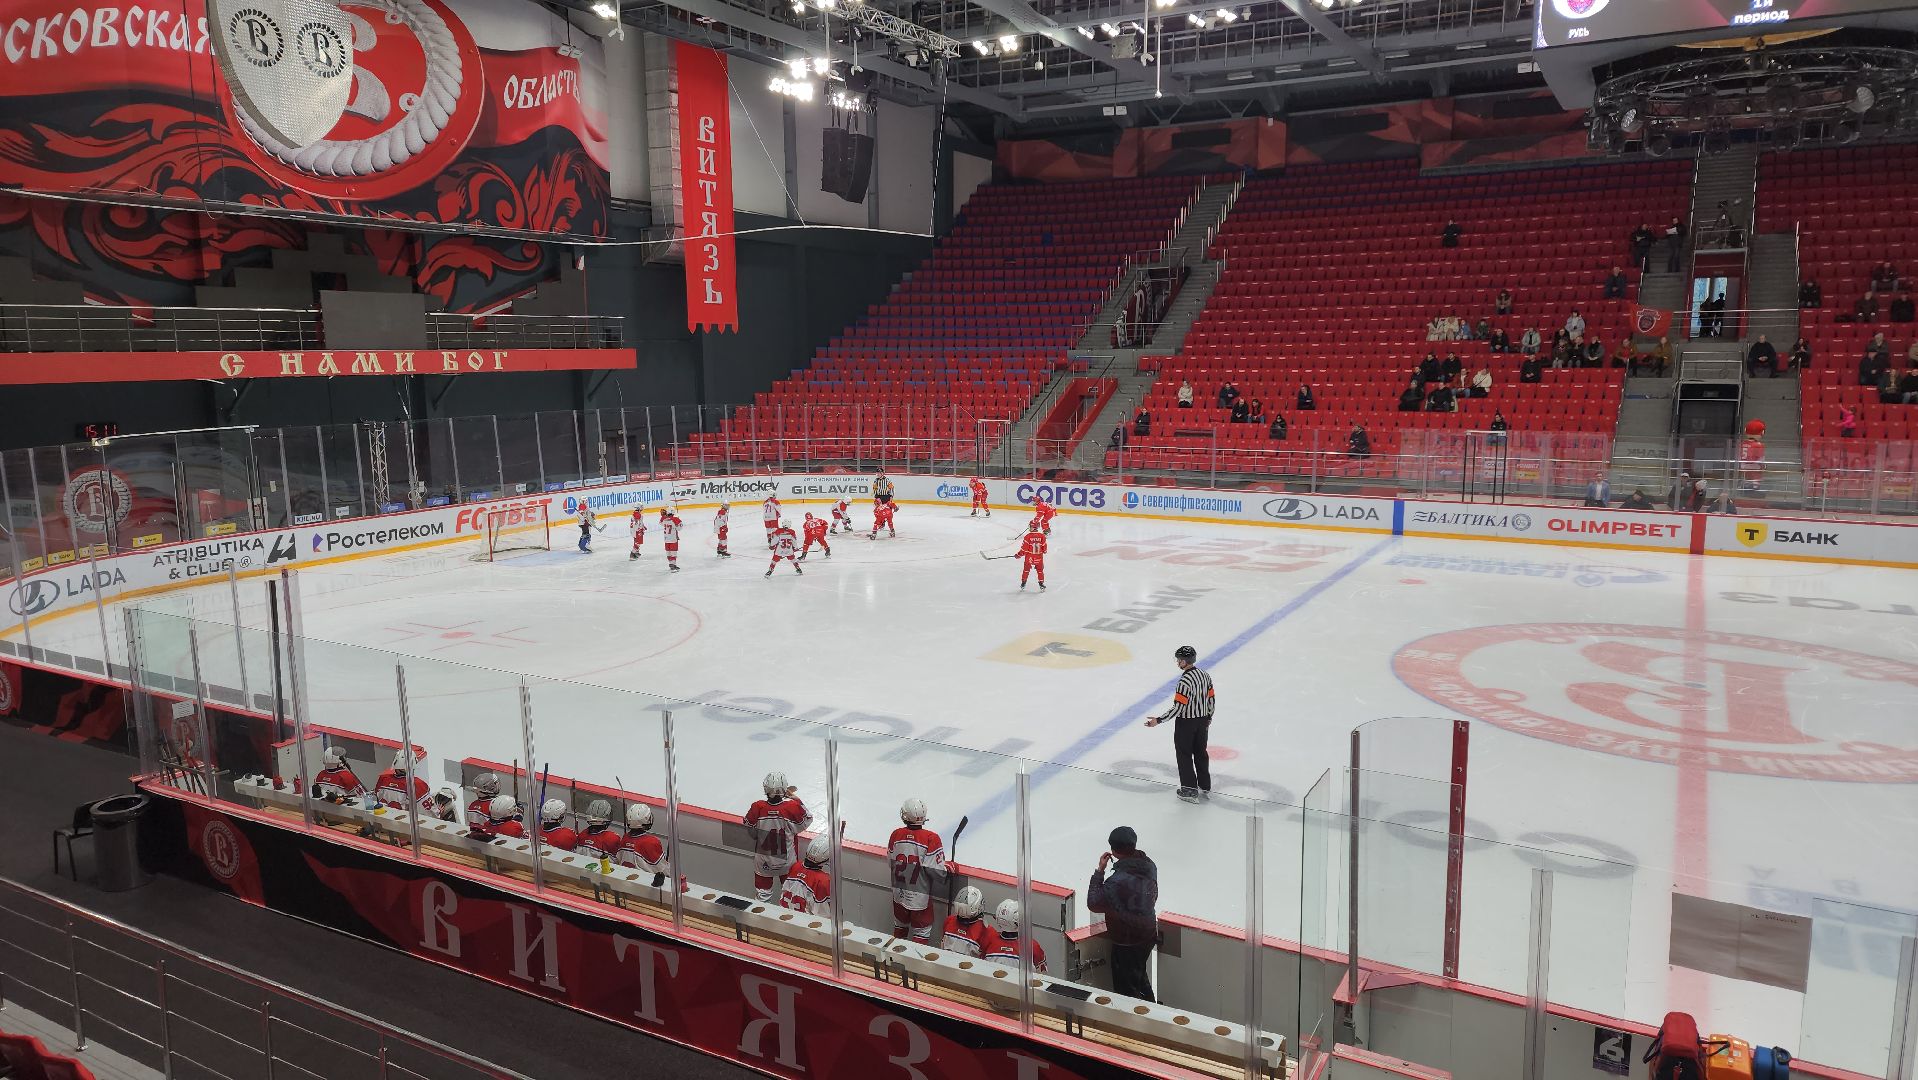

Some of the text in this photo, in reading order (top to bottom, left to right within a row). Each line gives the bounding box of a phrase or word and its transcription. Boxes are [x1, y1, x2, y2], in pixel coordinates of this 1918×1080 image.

[1734, 8, 1790, 25] период
[0, 5, 216, 63] СКОВСКАЯ
[1568, 27, 1590, 39] РУСЬ
[503, 69, 581, 109] ОБЛАСТЬ
[696, 116, 723, 305] ВИТЯЗЬ
[219, 350, 508, 376] С НАМИ БОГ
[700, 480, 780, 495] MarkHockey
[791, 485, 869, 495] GISLAVED
[455, 498, 553, 534] FONBET
[1323, 504, 1380, 521] LADA
[1427, 511, 1509, 528] БАЛТИКА
[326, 521, 444, 552] Ростелеком
[1546, 517, 1683, 539] OLIMPBET
[1773, 530, 1840, 546] БАНК
[153, 537, 265, 568] ATRIBUTIKA
[186, 557, 235, 577] CLUB
[66, 567, 127, 597] LADA
[1083, 584, 1217, 634] БАНК
[641, 690, 1034, 779] Haier
[760, 828, 787, 856] 41
[895, 853, 921, 885] 27
[418, 880, 1050, 1080] ВИТЯЗ
